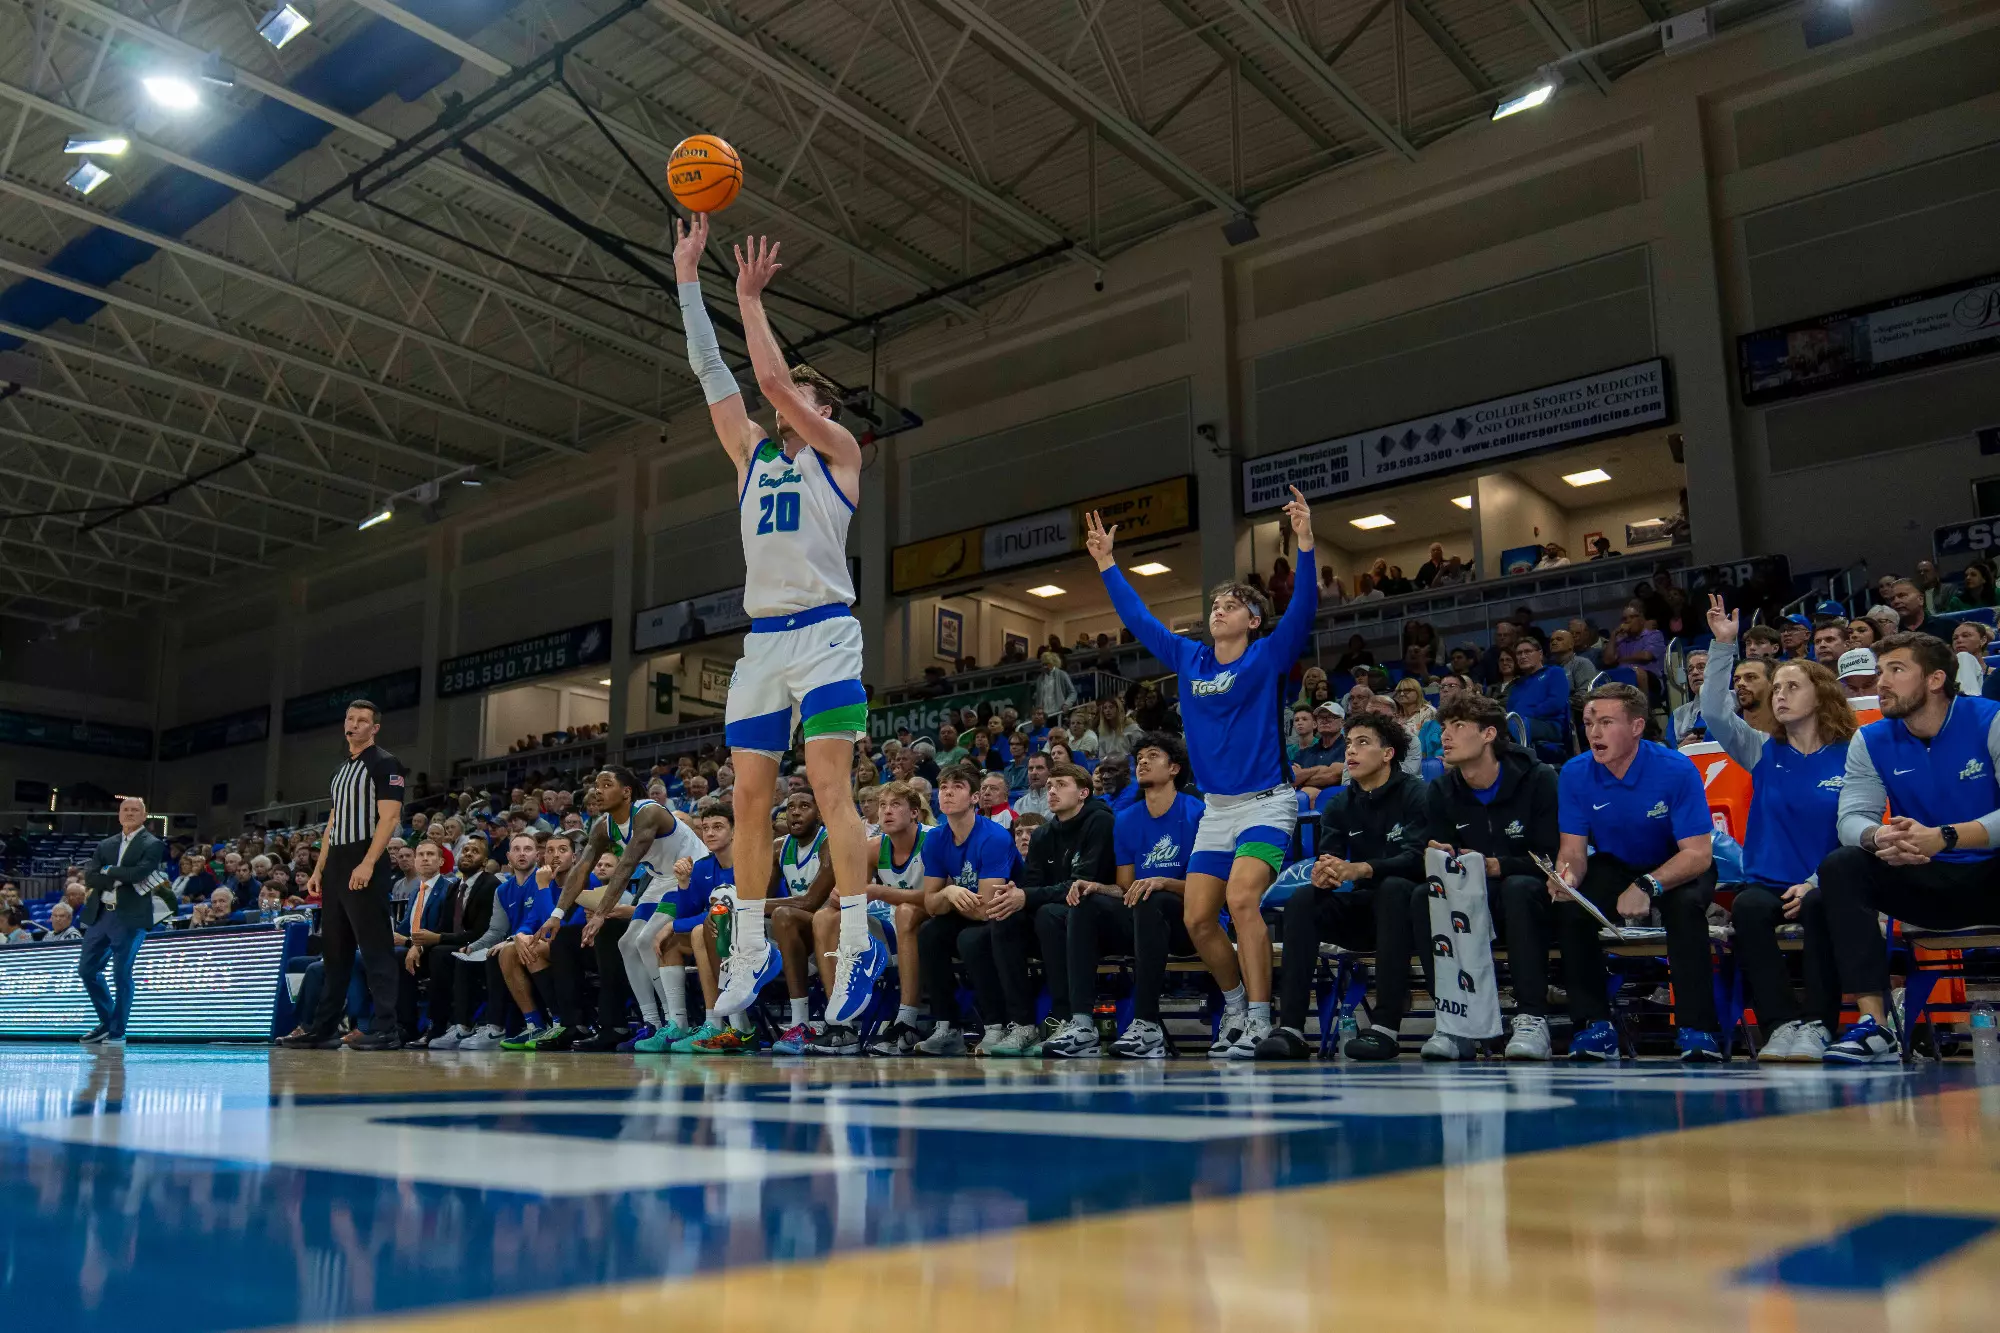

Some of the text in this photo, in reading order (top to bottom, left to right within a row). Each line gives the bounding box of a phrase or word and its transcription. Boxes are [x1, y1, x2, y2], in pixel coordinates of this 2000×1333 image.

[1475, 370, 1657, 424] COLLIER SPORTS MEDICINE
[1475, 384, 1659, 437] AND ORTHOPAEDIC CENTER
[1461, 401, 1662, 455] www.colliersportsmedicine.com
[758, 468, 803, 489] Eagles
[1251, 455, 1349, 490] James Guerra, MD
[1251, 470, 1350, 504] Brett Wlhoit, MD
[756, 491, 801, 536] 20
[1137, 494, 1154, 509] IT
[442, 647, 567, 692] 239.590.7145
